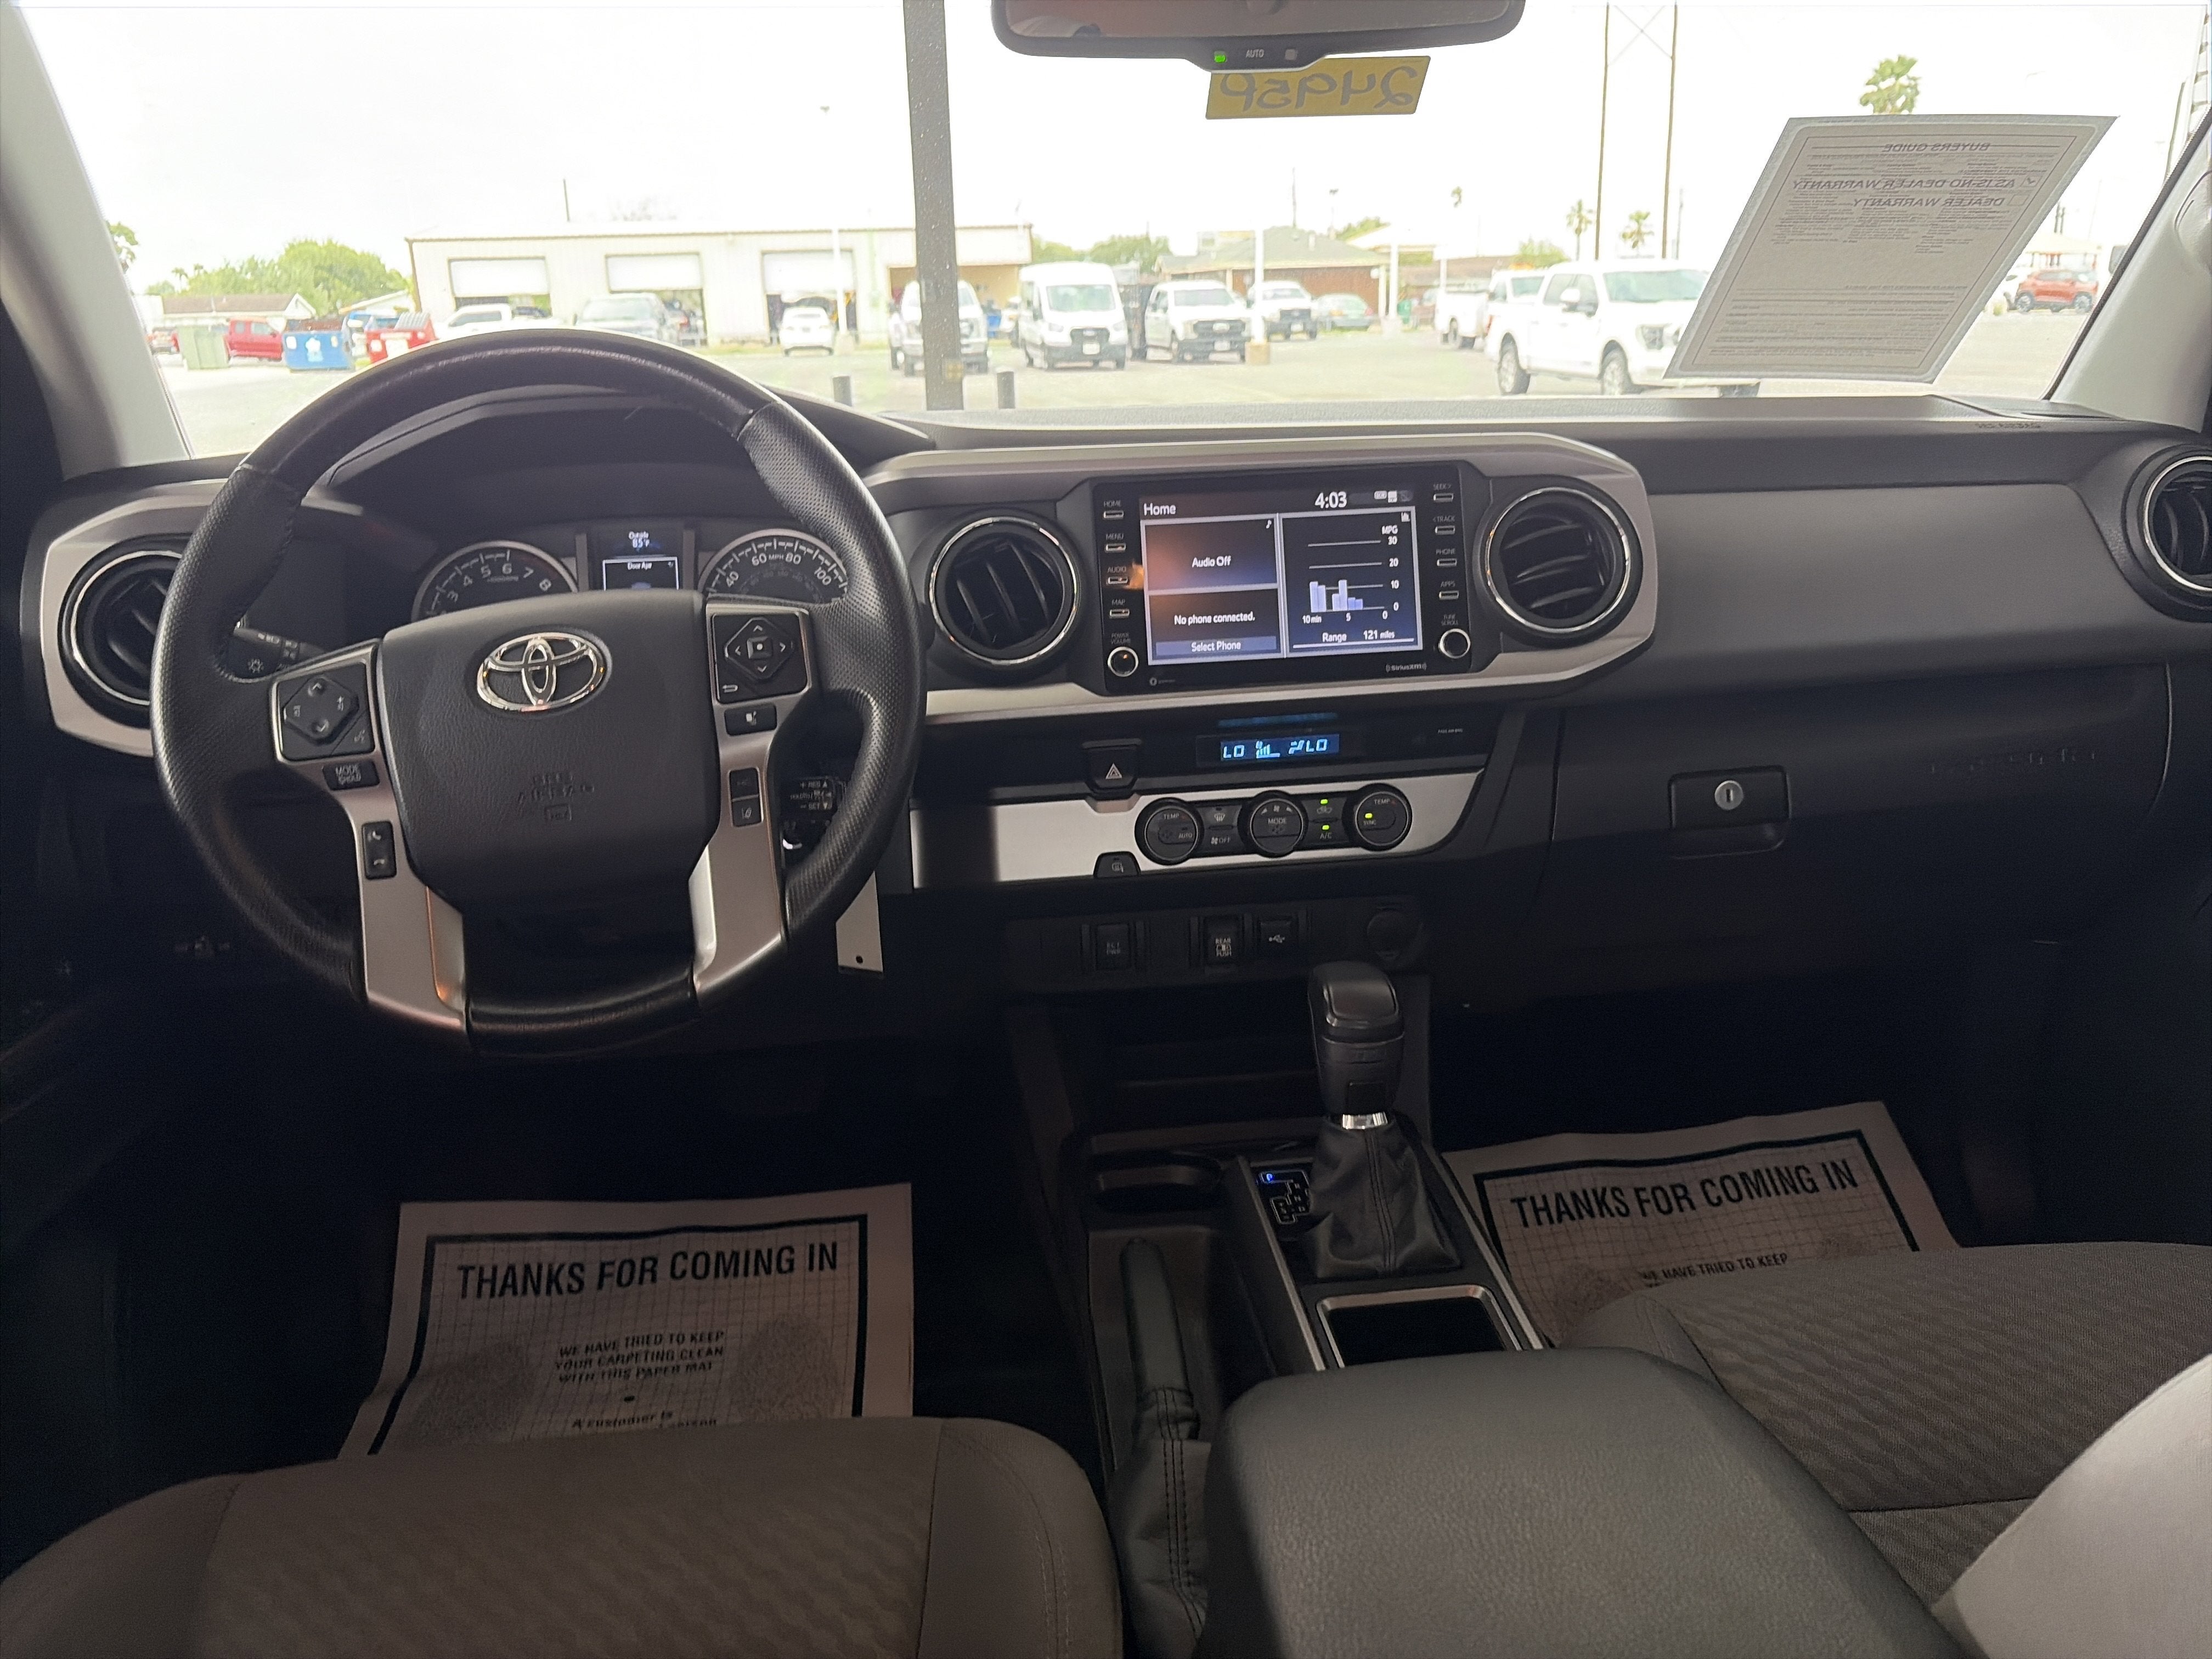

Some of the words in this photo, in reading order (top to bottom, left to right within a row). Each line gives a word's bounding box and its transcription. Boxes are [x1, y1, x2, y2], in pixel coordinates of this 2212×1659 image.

[1246, 49, 1265, 58] AUTO
[1314, 491, 1348, 509] 4:03
[1143, 503, 1176, 516] Home
[1381, 525, 1398, 535] MPG
[1388, 535, 1397, 545] 30
[752, 552, 767, 566] 60
[786, 552, 801, 565] 80
[1192, 557, 1215, 568] Audio
[1216, 555, 1232, 567] Off
[1389, 557, 1398, 567] 20
[481, 565, 491, 579] 5
[502, 563, 512, 574] 6
[523, 566, 534, 578] 7
[463, 574, 473, 588] 4
[726, 571, 739, 588] 40
[814, 567, 832, 586] 100
[539, 578, 551, 591] 8
[1391, 579, 1400, 589] 10
[1393, 601, 1400, 611] 0
[1174, 614, 1186, 625] No
[1187, 614, 1212, 626] phone
[1212, 611, 1256, 624] connected.
[1302, 615, 1311, 624] 10
[1311, 616, 1322, 624] min
[1346, 613, 1351, 622] 5
[1382, 610, 1389, 619] 0
[1322, 632, 1347, 644] Range
[1363, 630, 1378, 640] 121
[1379, 630, 1395, 639] miles
[1191, 641, 1215, 652] Select
[1216, 640, 1242, 651] Phone
[336, 764, 359, 777] MODE
[1268, 817, 1286, 826] MODE
[1510, 1186, 1631, 1228] THANKS
[1637, 1183, 1696, 1217] FOR
[1700, 1164, 1820, 1207] COMING
[1823, 1158, 1859, 1191] IN
[458, 1263, 585, 1299] THANKS
[597, 1257, 658, 1290] FOR
[670, 1248, 794, 1280] COMING
[807, 1241, 838, 1272] IN
[1662, 1264, 1696, 1279] HAVE
[1697, 1261, 1735, 1274] TRIED
[1736, 1257, 1755, 1270] TO
[1757, 1252, 1787, 1267] KEEP
[560, 1345, 579, 1358] WE
[585, 1340, 618, 1355] HAVE
[625, 1333, 663, 1349] TRIED
[669, 1333, 685, 1346] TO
[691, 1330, 724, 1343] KEEP
[555, 1358, 592, 1371] YOUR
[597, 1350, 675, 1368] CARPETING
[680, 1346, 723, 1361] CLEAN
[559, 1372, 595, 1384] WITH
[601, 1368, 631, 1380] THIS
[636, 1364, 680, 1379] PAPER
[686, 1361, 712, 1374] MAT
